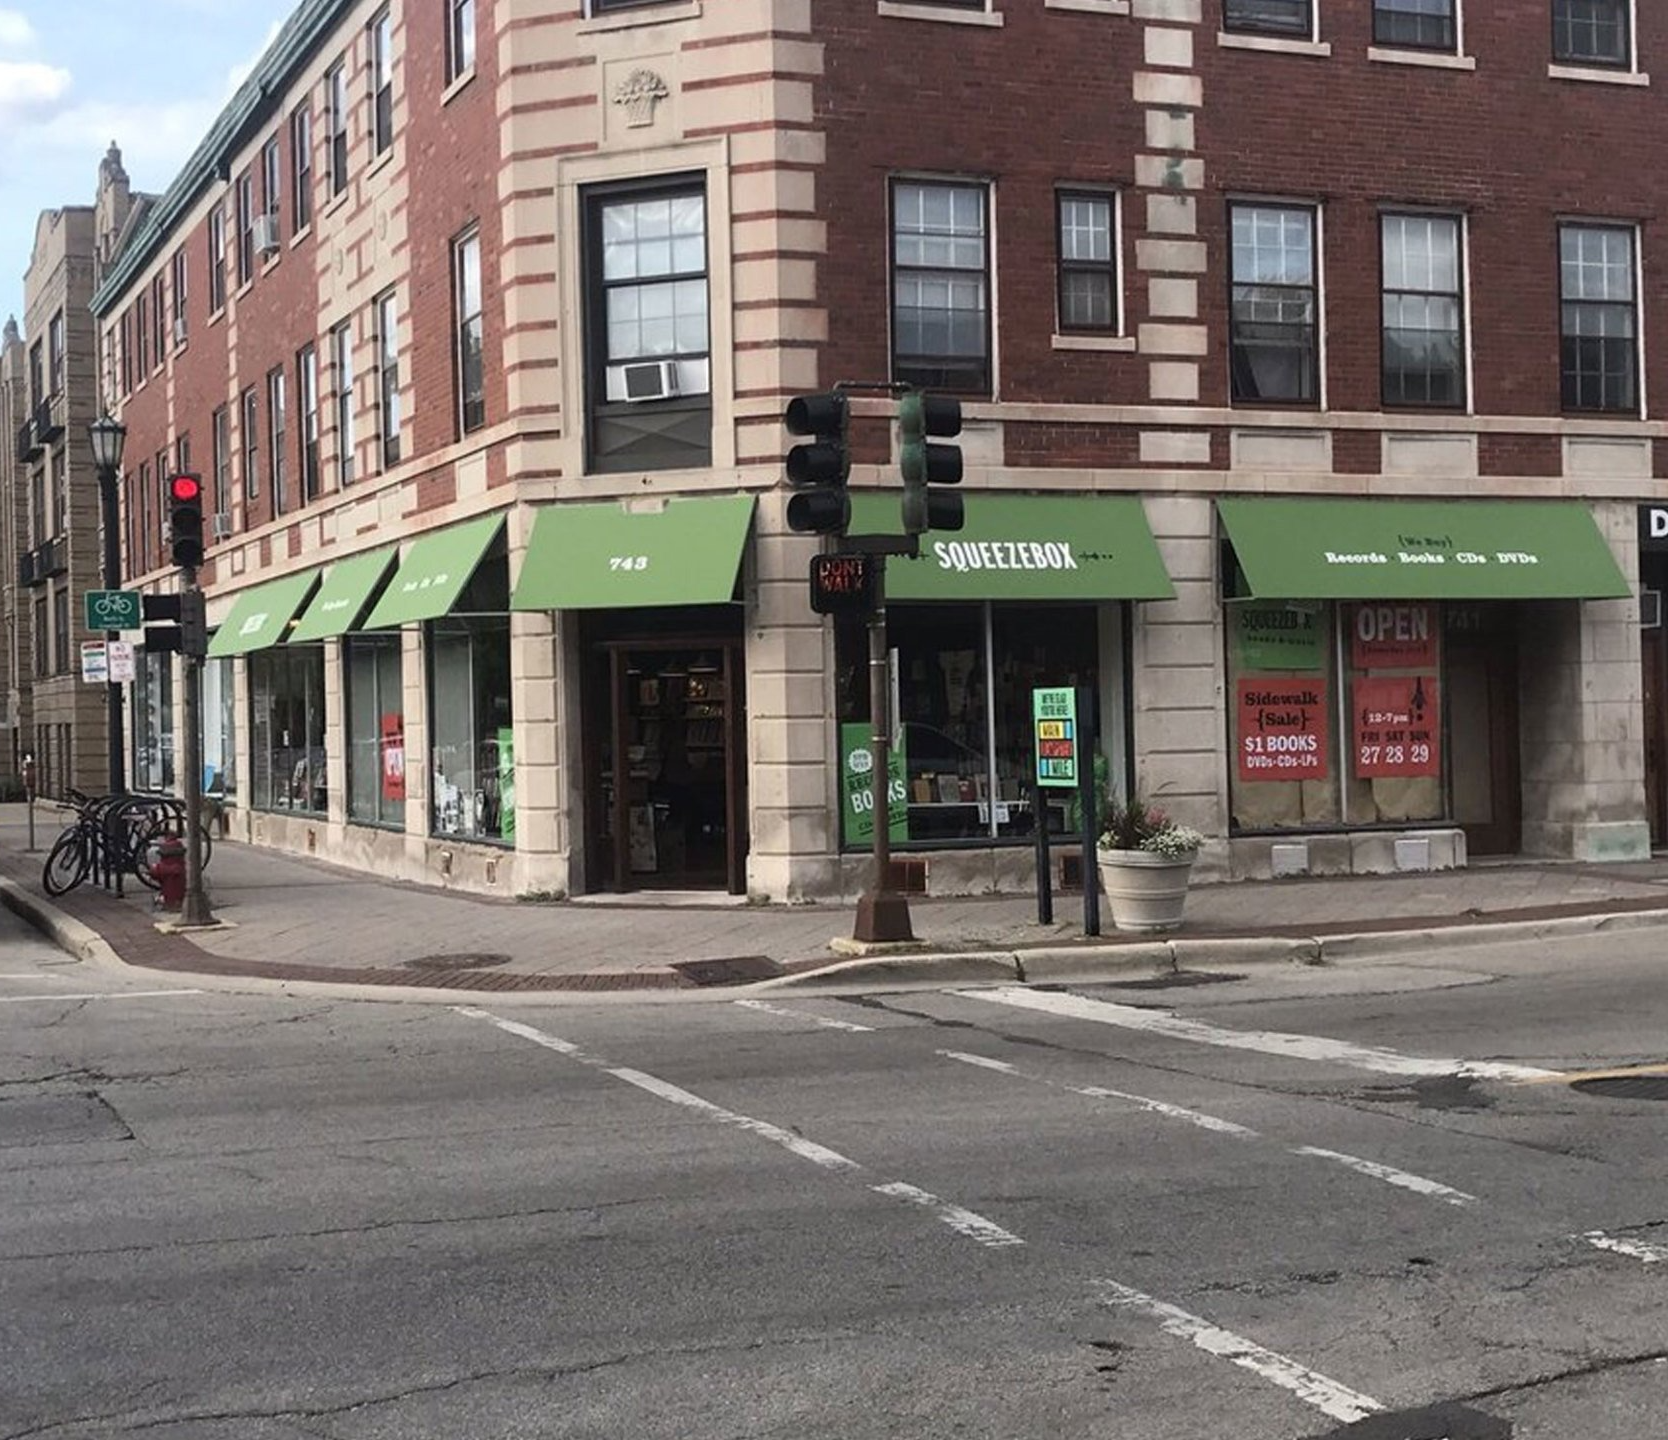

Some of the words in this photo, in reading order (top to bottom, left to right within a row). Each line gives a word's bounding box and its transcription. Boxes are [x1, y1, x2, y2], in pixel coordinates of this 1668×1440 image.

[610, 556, 649, 571] 743
[933, 541, 1078, 573] SQUEEZEBOX
[1324, 552, 1388, 564] Records
[1398, 552, 1445, 564] Books
[1456, 552, 1487, 564] CDs
[1497, 552, 1539, 564] DVDs
[1357, 607, 1429, 641] OPEN
[1244, 691, 1319, 706] Sidewalk
[1244, 736, 1264, 752] $1
[1266, 734, 1318, 751] BOOKS
[1386, 731, 1405, 741] SAT
[1361, 745, 1380, 764] 27
[1385, 745, 1404, 763] 28
[1411, 744, 1429, 763] 29
[850, 780, 907, 814] BOKS
